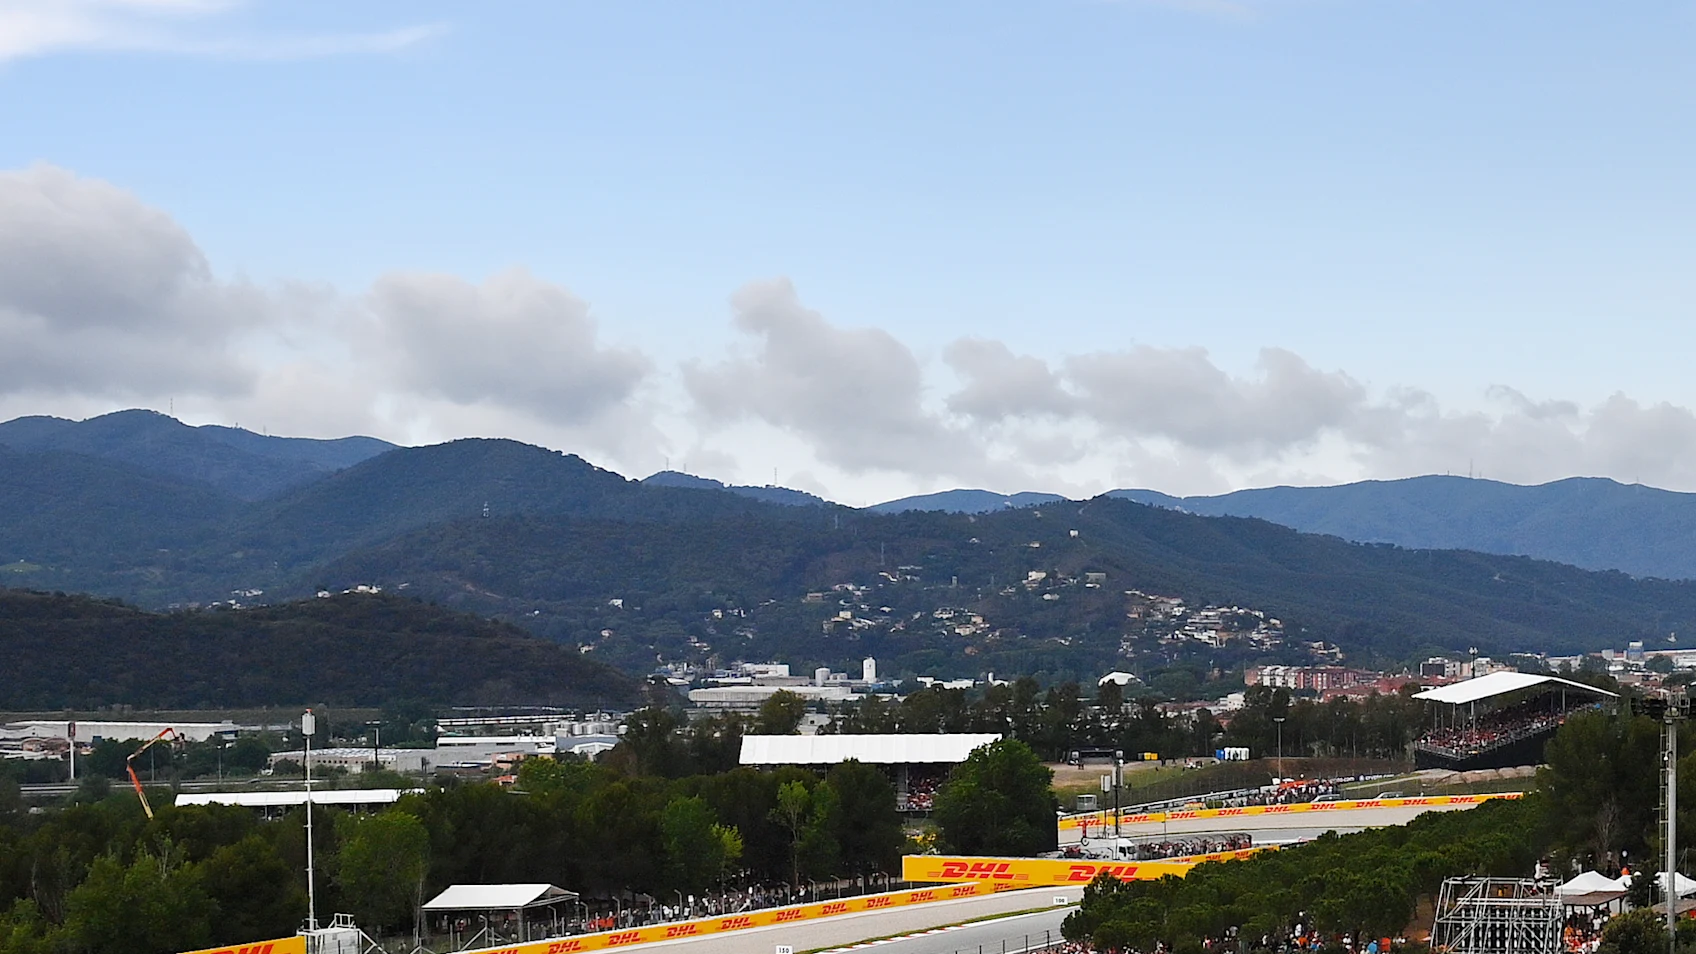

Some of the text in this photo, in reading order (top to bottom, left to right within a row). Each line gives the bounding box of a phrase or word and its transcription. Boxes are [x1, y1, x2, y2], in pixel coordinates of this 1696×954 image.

[1310, 802, 1336, 811] DHL
[1355, 800, 1382, 809] DHL
[1402, 798, 1429, 807] DHL
[1450, 796, 1476, 805] DHL
[1171, 811, 1197, 820] DHL
[1217, 808, 1244, 817] DHL
[1264, 805, 1290, 814] DHL
[1124, 815, 1151, 824] DHL
[941, 862, 1015, 881] DHL
[910, 890, 935, 903] DHL
[952, 885, 976, 897] DHL
[822, 902, 848, 915] DHL
[866, 896, 891, 909] DHL
[775, 908, 803, 922] DHL
[720, 916, 752, 930] DHL
[667, 924, 698, 938] DHL
[608, 931, 643, 946] DHL
[548, 940, 582, 954] DHL
